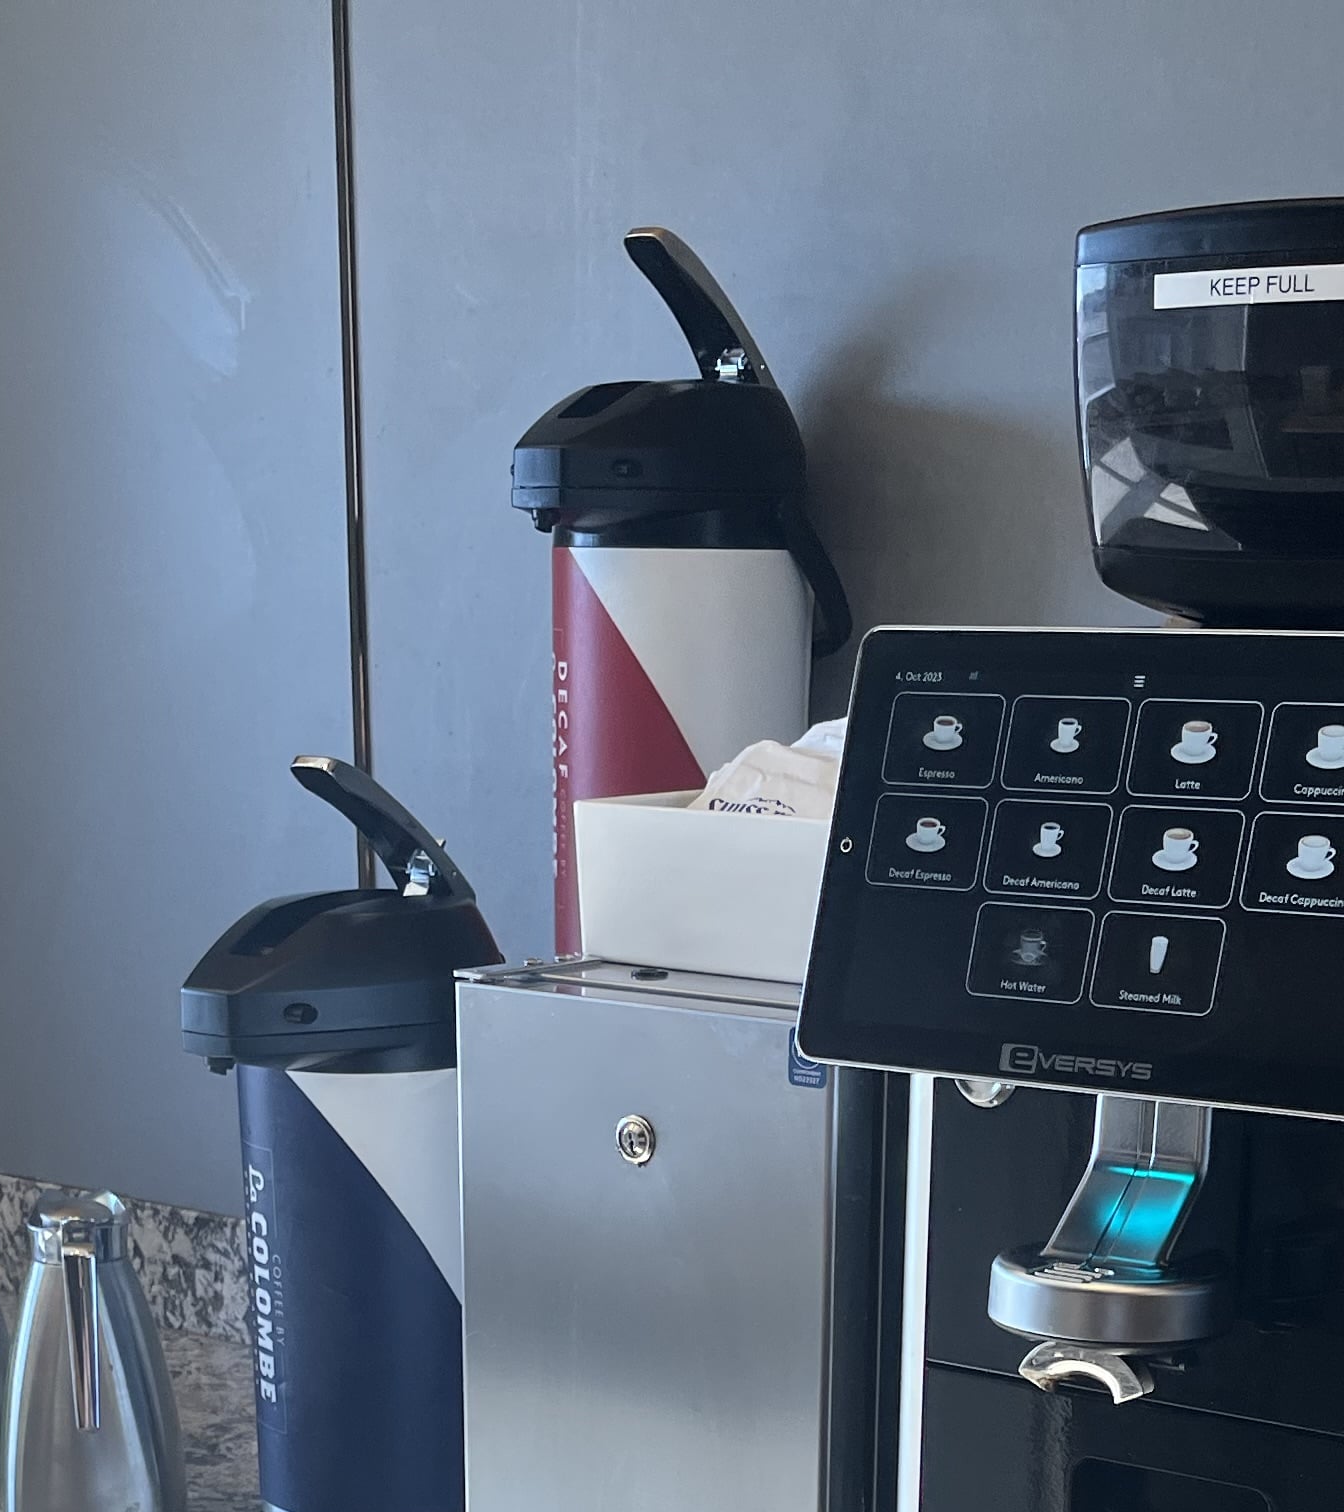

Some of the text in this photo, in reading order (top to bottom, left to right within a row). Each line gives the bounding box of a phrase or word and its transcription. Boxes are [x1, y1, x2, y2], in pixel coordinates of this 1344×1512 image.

[1210, 273, 1315, 297] KEEP FULL
[905, 671, 922, 682] Oct
[922, 671, 943, 683] 2023
[556, 660, 569, 779] DECAF
[918, 767, 956, 780] Espresso
[1033, 772, 1084, 785] Americano
[1174, 779, 1201, 790] Latte
[888, 867, 952, 882] Decaf Espresso
[1002, 874, 1080, 891] Decaf Americano
[1141, 884, 1197, 898] Decaf Latte
[1258, 891, 1290, 904] Decaf
[1000, 979, 1046, 993] Hot Water
[1118, 989, 1182, 1005] Steamed Milk
[248, 1163, 266, 1203] La
[251, 1210, 278, 1405] COLOMBE
[272, 1253, 287, 1347] COFFEE BY
